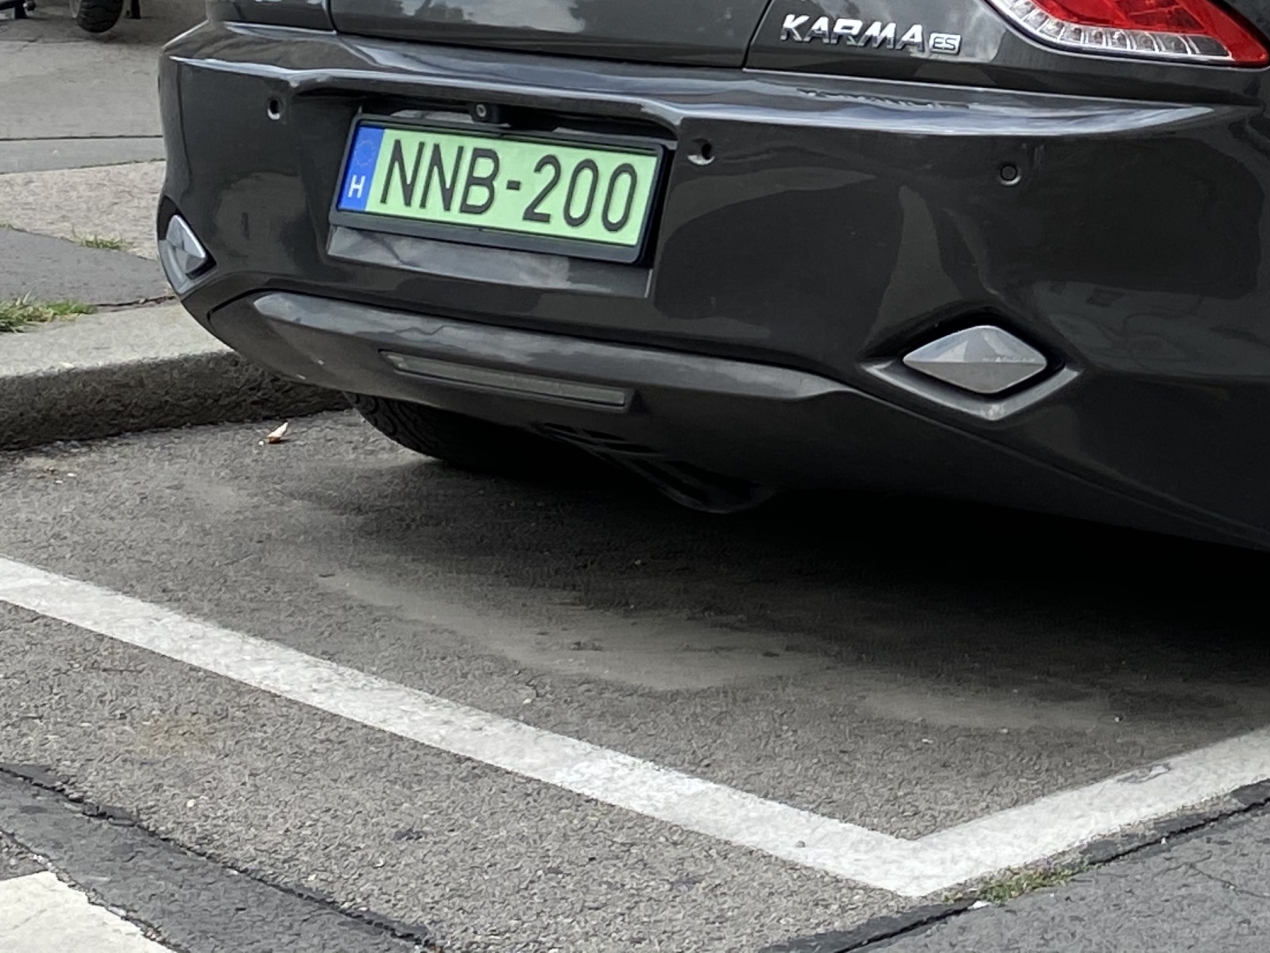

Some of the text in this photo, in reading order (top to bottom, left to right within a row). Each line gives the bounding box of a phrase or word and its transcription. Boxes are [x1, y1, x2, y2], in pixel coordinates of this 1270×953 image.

[780, 14, 958, 52] KARMA ES
[347, 174, 365, 199] H
[380, 139, 638, 232] NNB-200
